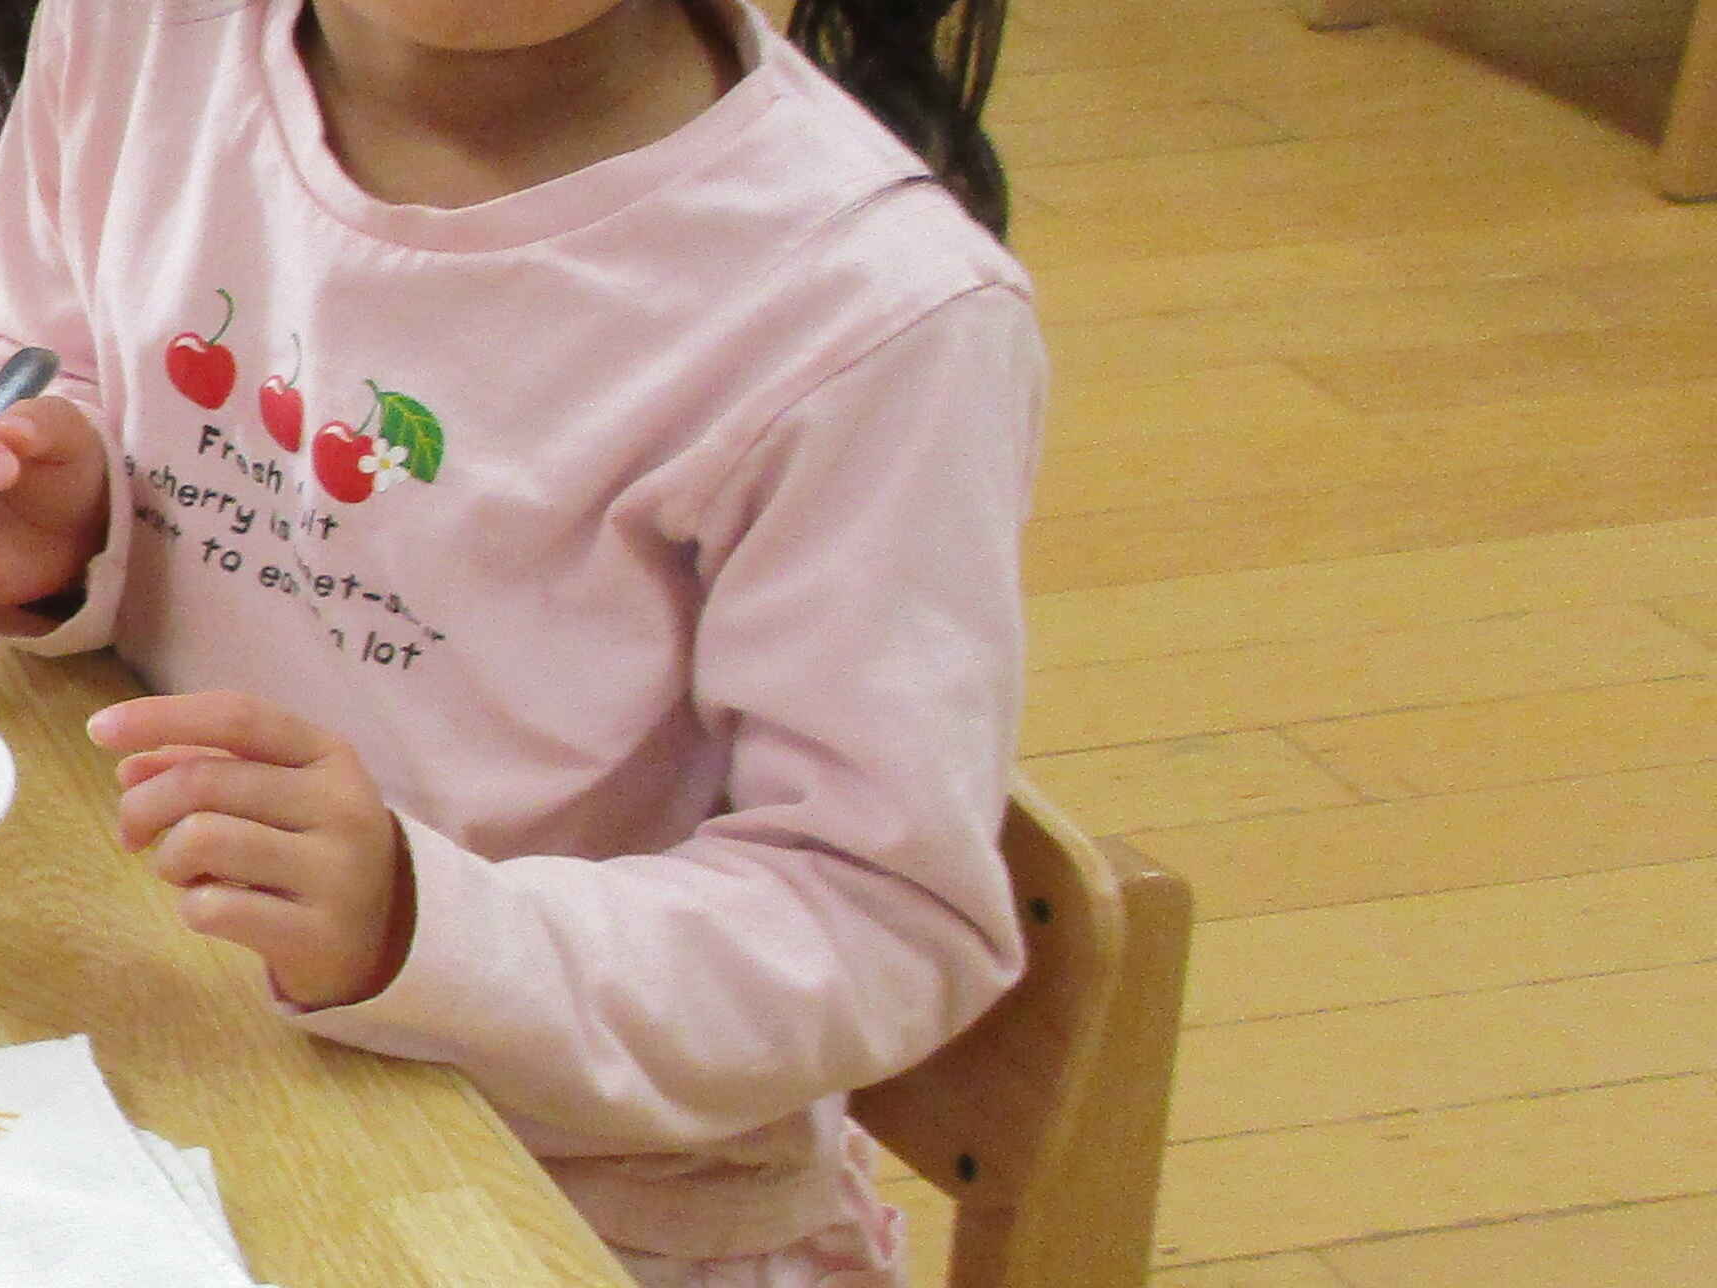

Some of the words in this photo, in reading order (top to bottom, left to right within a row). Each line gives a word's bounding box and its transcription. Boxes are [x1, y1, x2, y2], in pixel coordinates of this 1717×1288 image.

[149, 464, 256, 534] cherry
[202, 536, 243, 573] to
[362, 630, 422, 670] lot
